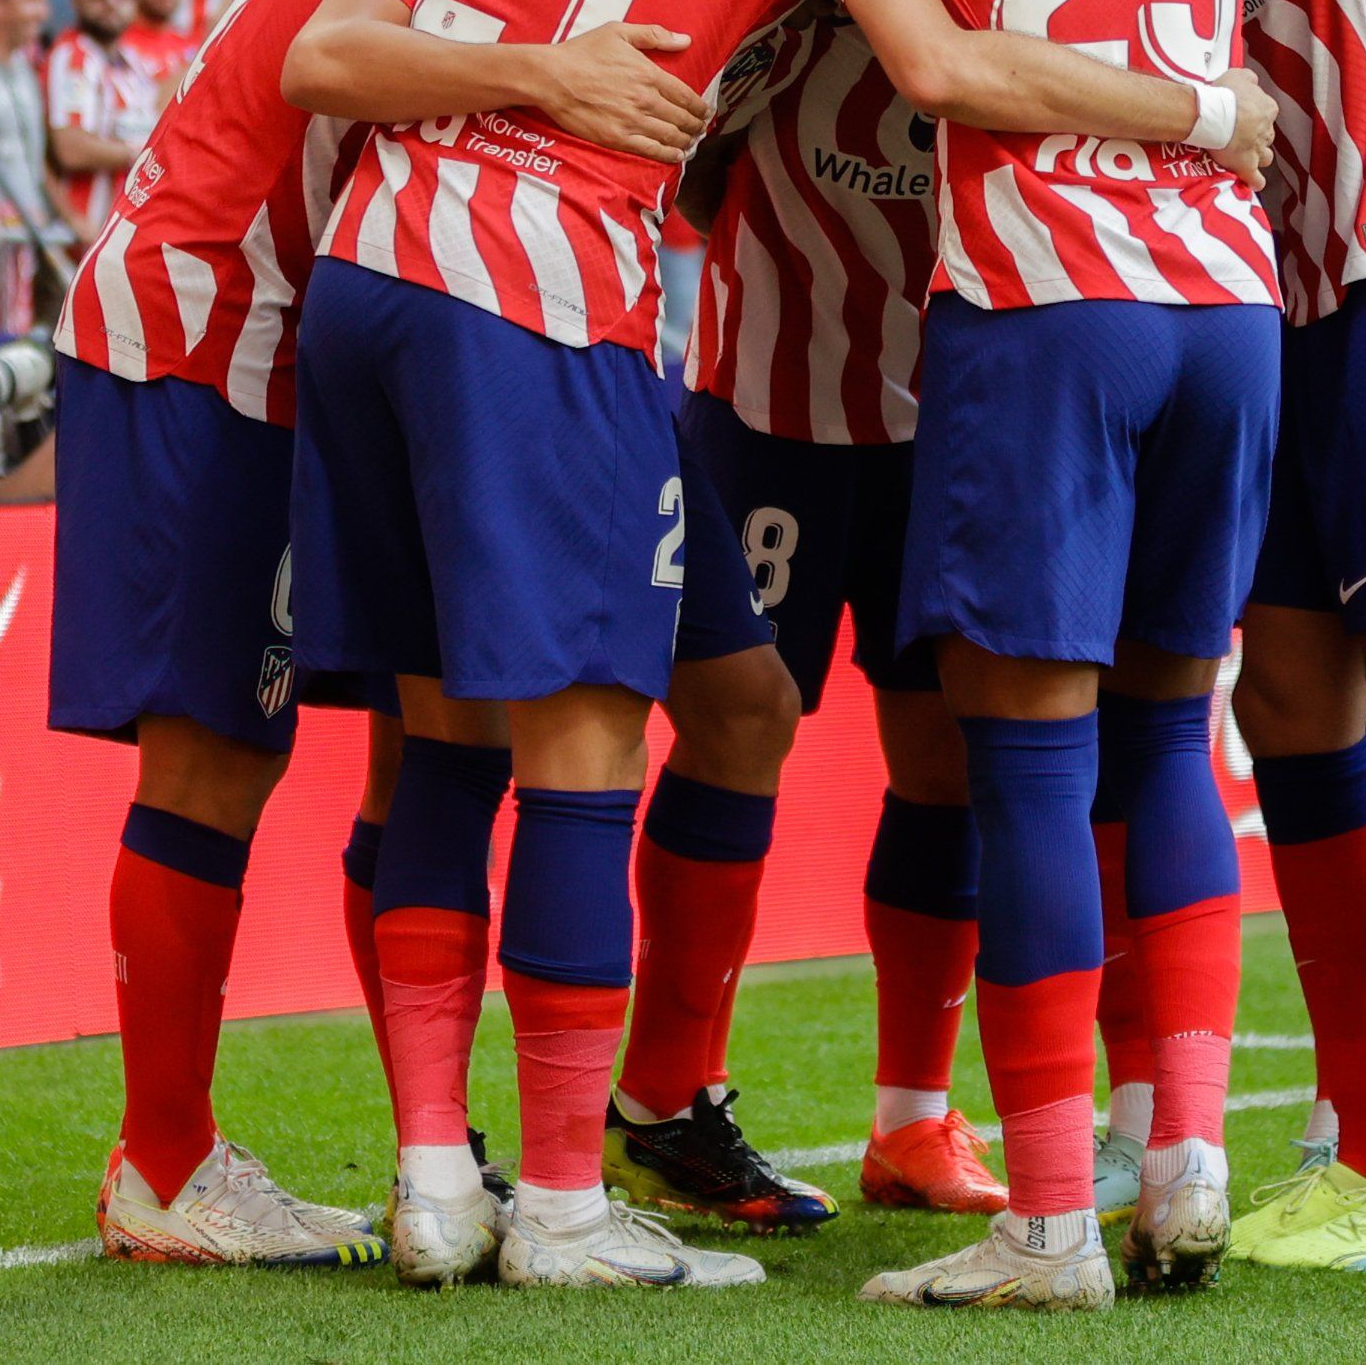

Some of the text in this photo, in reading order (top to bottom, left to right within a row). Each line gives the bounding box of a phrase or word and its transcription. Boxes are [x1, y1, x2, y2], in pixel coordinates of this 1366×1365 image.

[465, 131, 563, 176] Transfer
[476, 112, 556, 150] Money
[814, 146, 934, 197] Whale
[1034, 134, 1157, 182] ria
